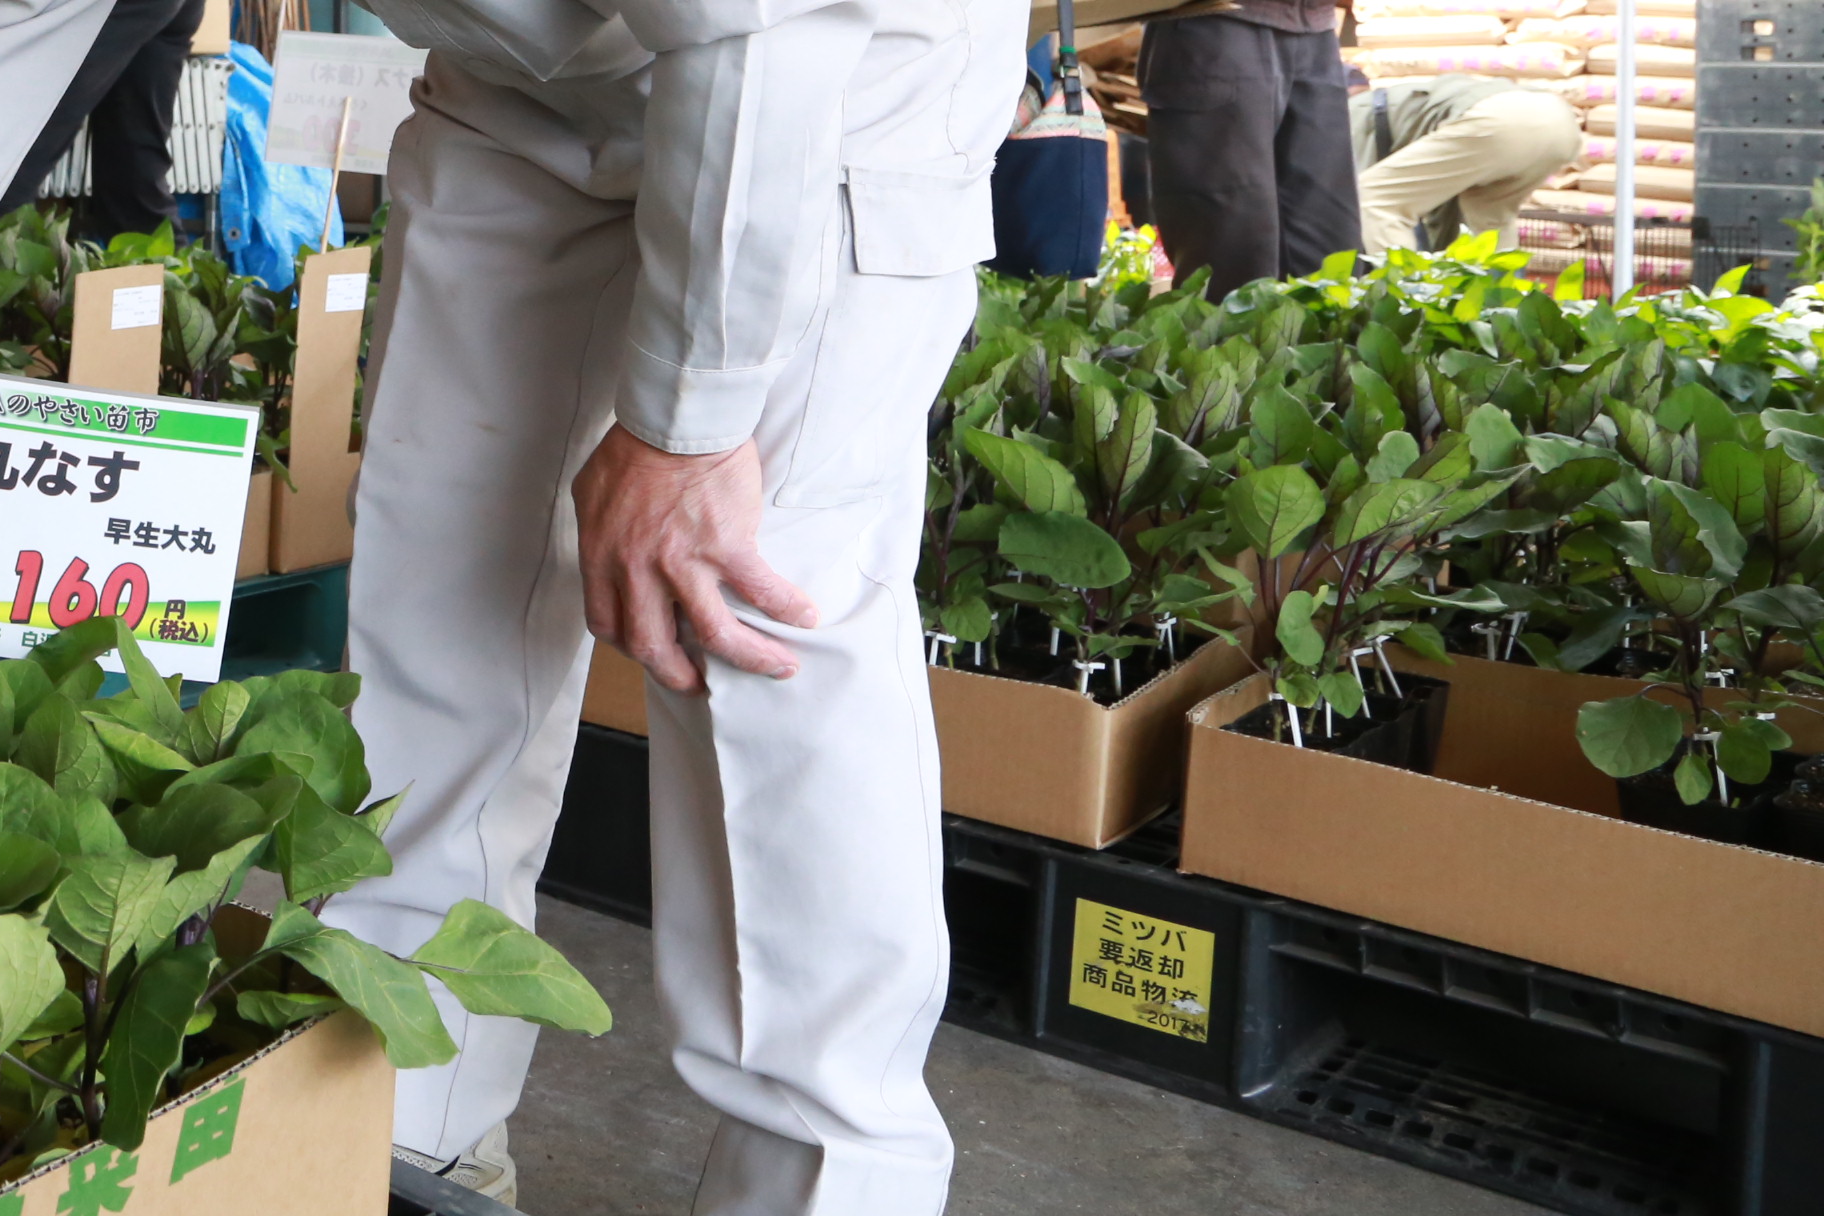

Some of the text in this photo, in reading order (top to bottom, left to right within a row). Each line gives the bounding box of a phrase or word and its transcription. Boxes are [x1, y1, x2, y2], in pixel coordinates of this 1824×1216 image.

[104, 517, 217, 555] 早生大丸
[9, 550, 150, 631] 160
[164, 599, 186, 618] 円
[1102, 910, 1187, 952] ミツバ
[1098, 937, 1185, 980] 要返却
